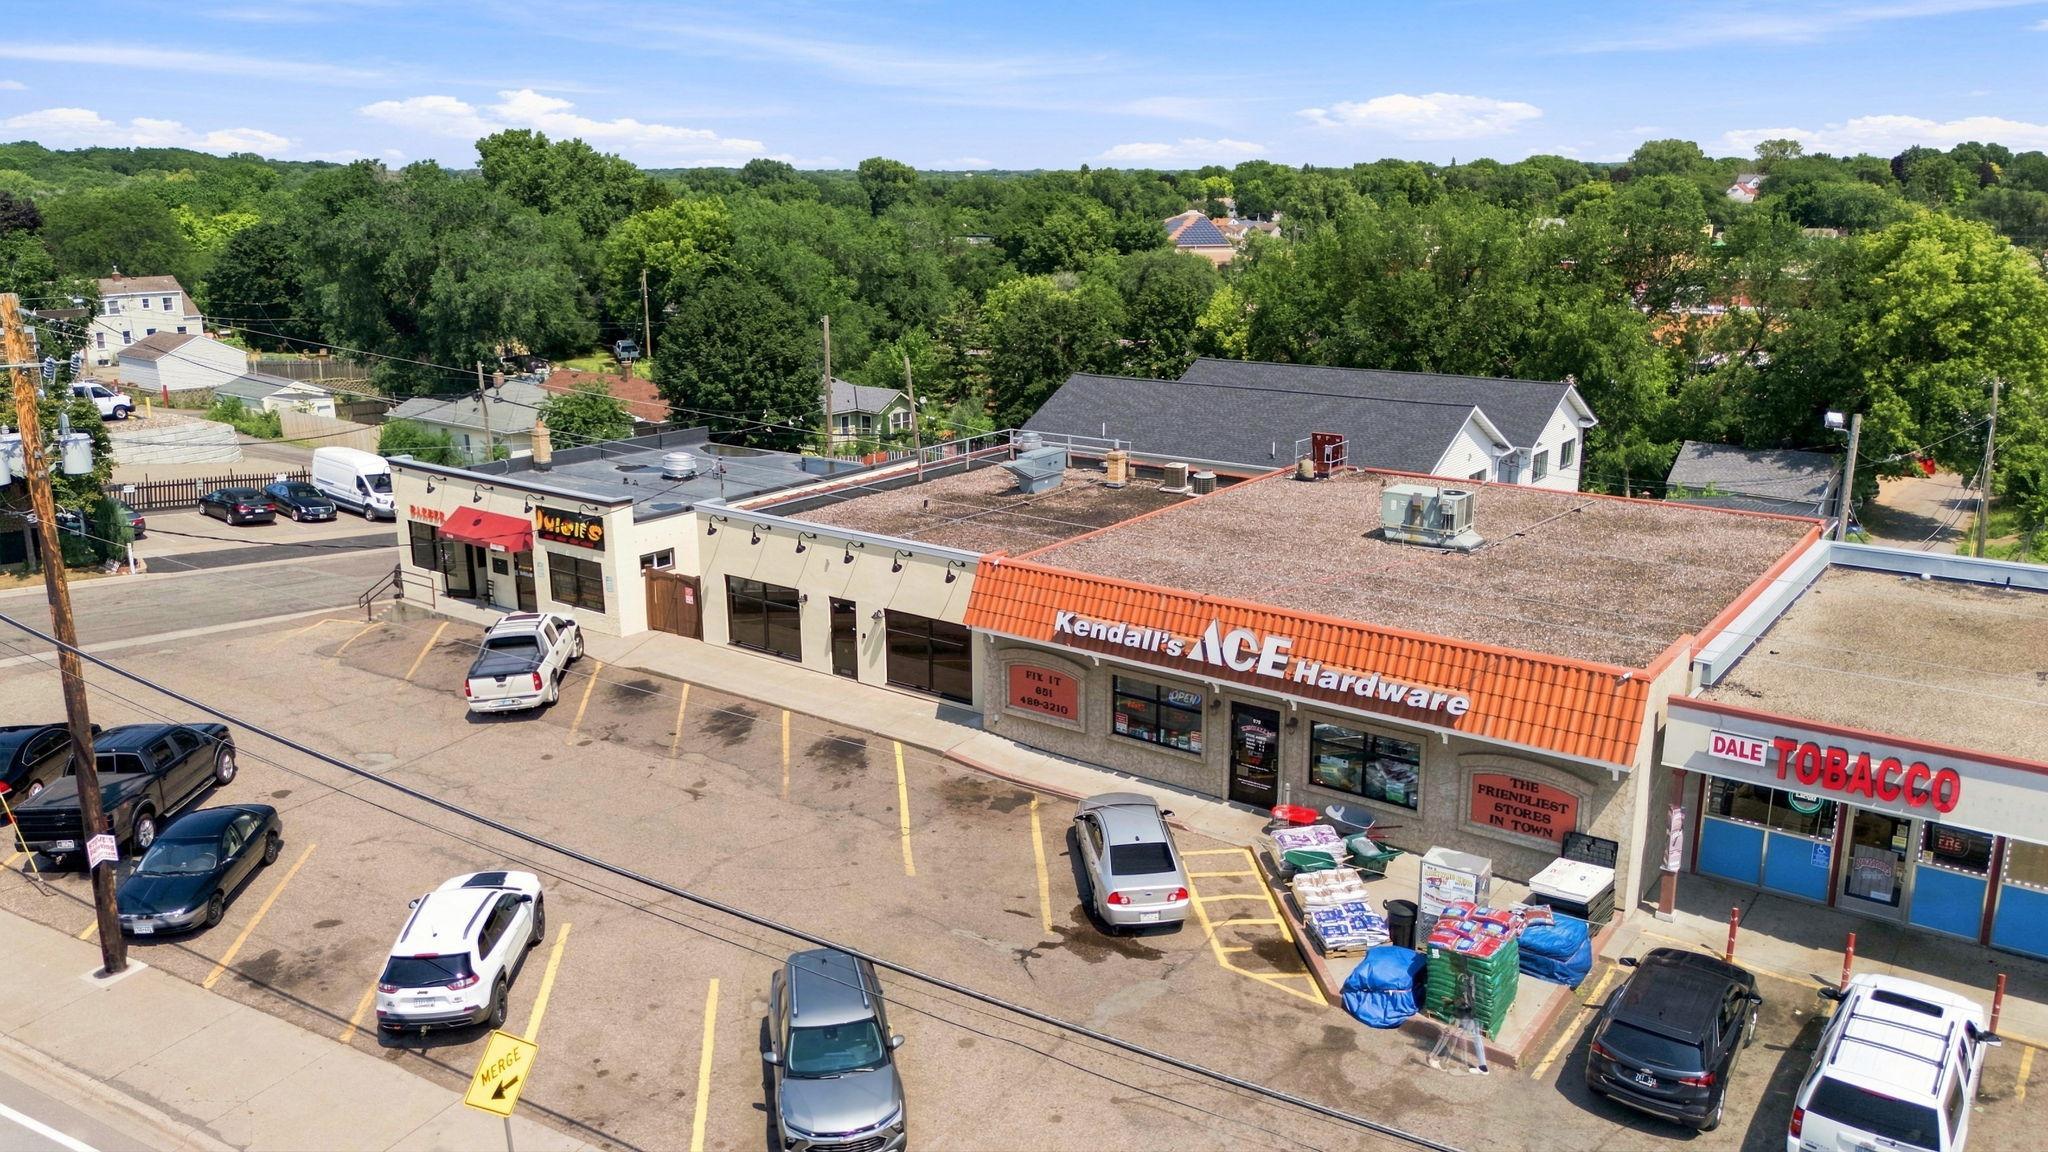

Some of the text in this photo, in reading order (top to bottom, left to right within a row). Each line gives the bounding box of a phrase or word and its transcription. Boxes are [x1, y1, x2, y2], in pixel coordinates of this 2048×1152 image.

[410, 505, 445, 521] BARBER
[1054, 610, 1471, 715] Kendall's ACE Hardware
[1025, 670, 1062, 687] FIX IT
[1035, 686, 1053, 698] 651
[1171, 690, 1198, 705] OPEN
[1020, 696, 1068, 715] 489-3210
[1713, 736, 1961, 813] DALE TOBACCO
[1510, 777, 1540, 794] THE
[1477, 783, 1569, 815] FRIENDLIEST
[1494, 802, 1552, 825] STORES
[1489, 814, 1554, 838] IN TOWN
[481, 1047, 522, 1087] MERGE
